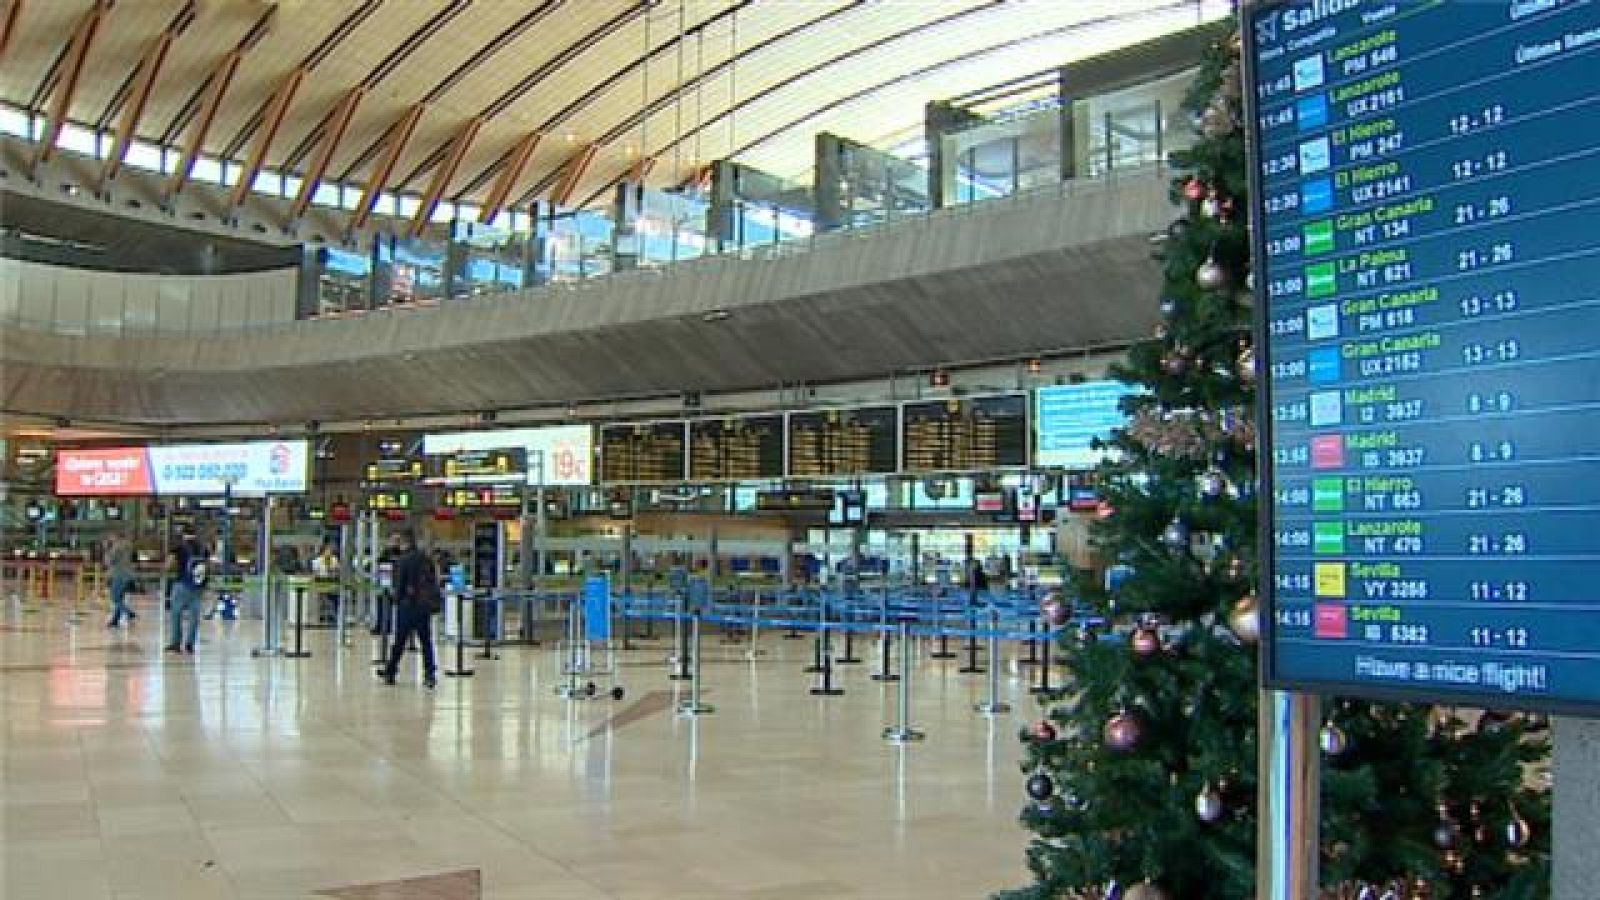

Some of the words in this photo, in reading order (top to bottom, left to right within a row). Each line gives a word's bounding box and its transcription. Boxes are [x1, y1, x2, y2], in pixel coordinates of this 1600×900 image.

[1327, 30, 1396, 63] Lanzarote
[1329, 72, 1400, 103] Lanzarote
[1337, 212, 1372, 231] Gran
[1375, 198, 1433, 221] Canaria
[1355, 225, 1376, 244] NT
[1359, 249, 1406, 267] Palma
[1357, 269, 1377, 286] NT
[1341, 299, 1376, 316] Gran
[1379, 287, 1438, 308] Canaria
[1462, 296, 1481, 316] 13
[1496, 291, 1516, 311] 13
[1360, 312, 1382, 331] PM
[1342, 343, 1378, 359] Gran
[1381, 332, 1441, 352] Canaria
[1463, 344, 1482, 364] 13
[1499, 339, 1519, 360] 13
[1344, 384, 1396, 405] Madrid
[1345, 431, 1397, 450] Madrid
[1363, 476, 1412, 492] Hierro
[1364, 494, 1386, 511] NT
[1347, 519, 1421, 537] Lanzarote
[1364, 537, 1386, 553] NT
[1350, 561, 1400, 578] Sevilla
[1364, 580, 1386, 597] VY
[1470, 581, 1489, 601] 11
[1504, 582, 1526, 601] 12
[1350, 605, 1401, 621] Sevilla
[1470, 627, 1491, 646] 11
[1505, 627, 1528, 647] 12
[1354, 655, 1410, 679] Have
[1413, 662, 1431, 681] a
[1431, 660, 1479, 684] nice
[1481, 662, 1546, 693] flight!
